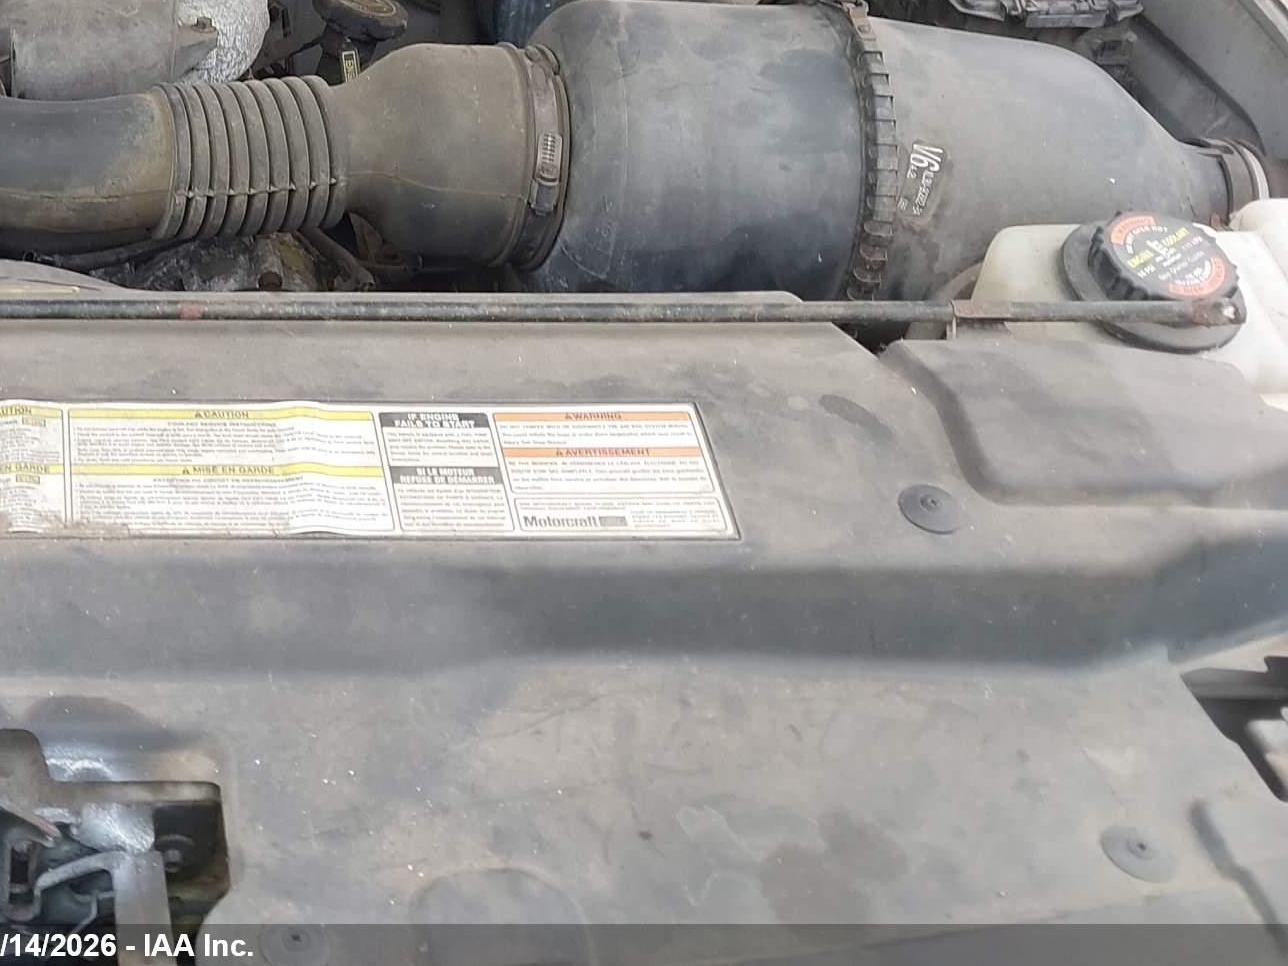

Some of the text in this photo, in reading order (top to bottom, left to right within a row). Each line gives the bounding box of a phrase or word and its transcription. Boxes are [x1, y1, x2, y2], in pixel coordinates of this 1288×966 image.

[204, 410, 249, 419] CAUTION
[407, 413, 459, 421] IF ENGINE
[574, 412, 623, 420] WARNING
[394, 420, 475, 428] FAILS TO START
[565, 448, 650, 457] AVERTISSEMENT
[193, 465, 274, 475] MISE EN GARDE
[428, 468, 438, 476] LE
[440, 468, 475, 476] MOTEUR
[400, 475, 433, 484] REFUSE
[435, 476, 445, 484] DE
[523, 515, 599, 528] Motorcraft
